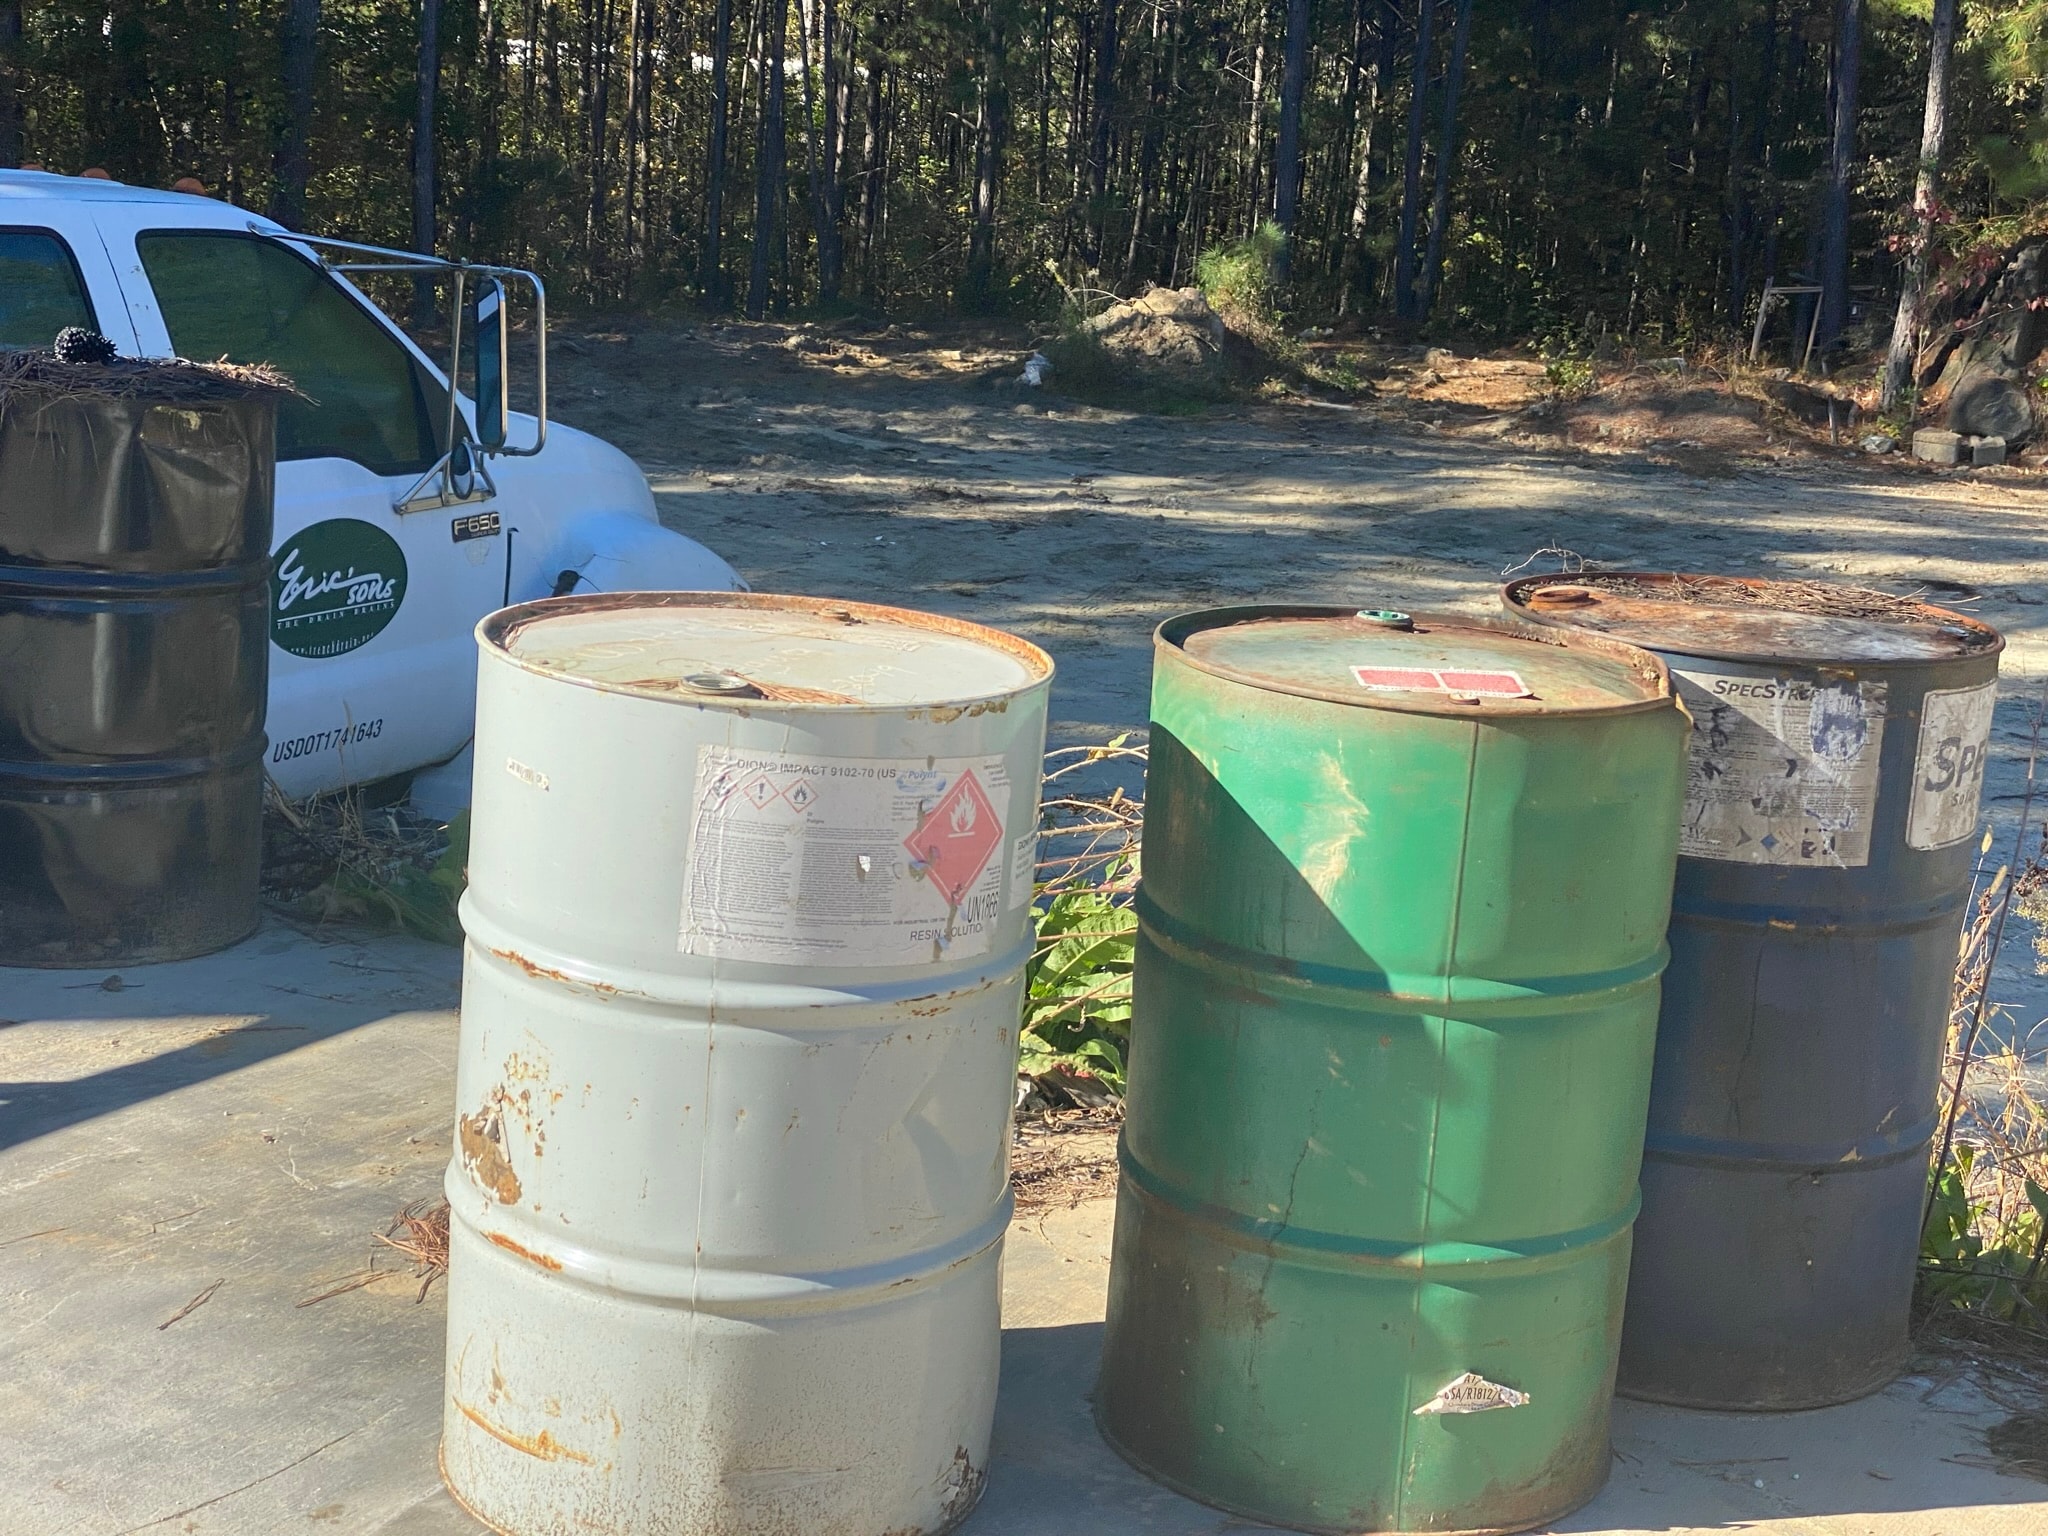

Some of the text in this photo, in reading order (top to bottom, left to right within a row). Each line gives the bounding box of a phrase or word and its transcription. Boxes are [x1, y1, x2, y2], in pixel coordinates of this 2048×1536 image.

[277, 601, 396, 630] THE DRAIN BRAINS
[273, 718, 384, 763] USDOT1741643
[780, 763, 827, 777] IMPACT
[830, 766, 874, 778] 9102-70
[876, 768, 896, 780] (US
[908, 769, 938, 781] Polynt
[910, 922, 984, 941] RESIN OLUTIO
